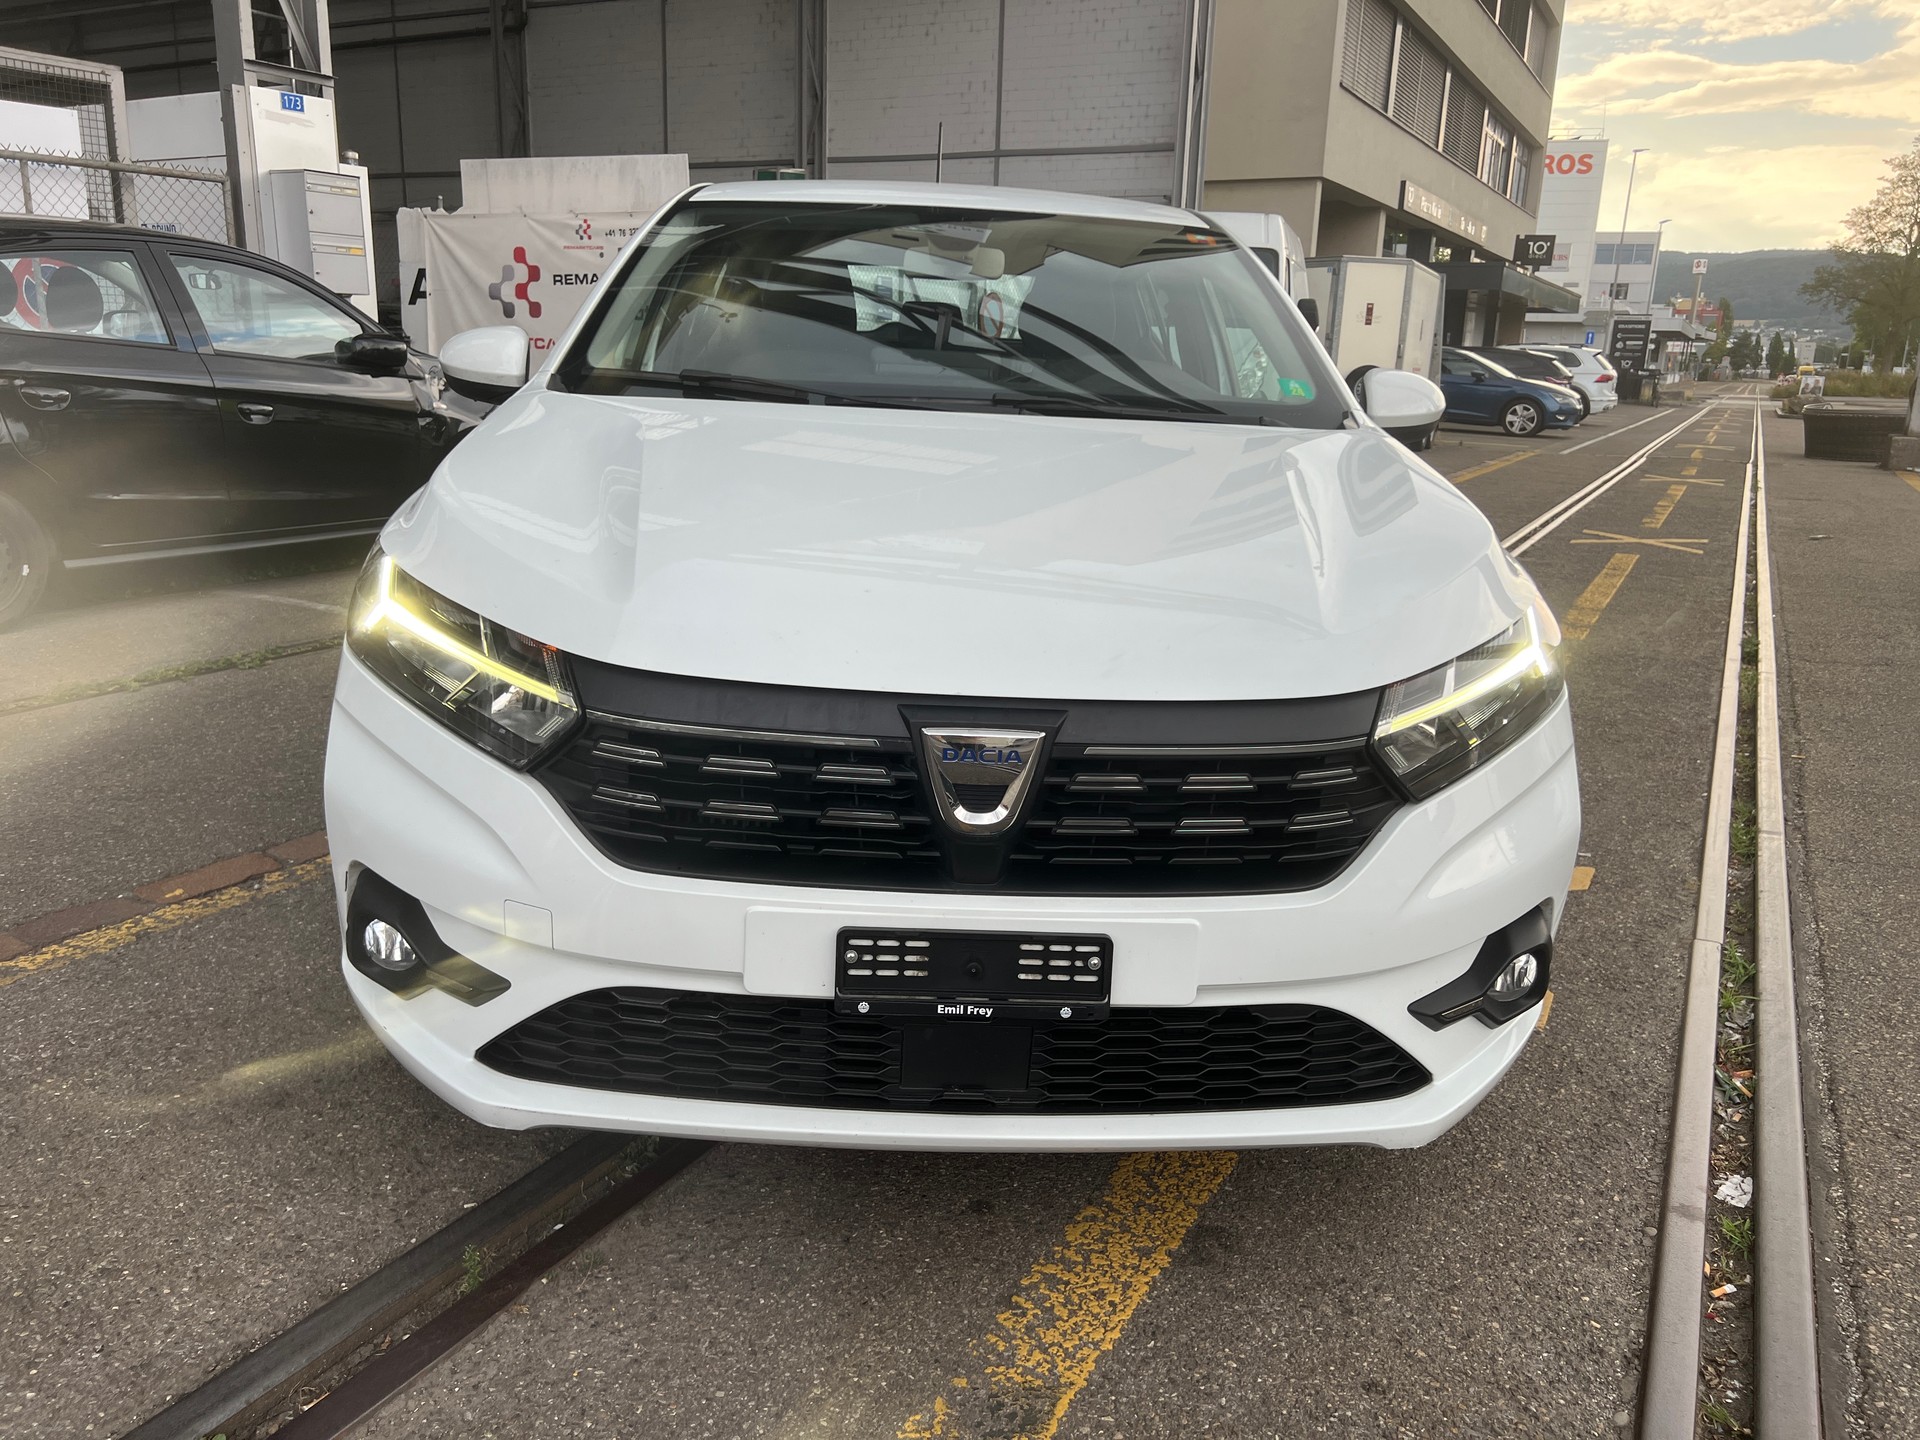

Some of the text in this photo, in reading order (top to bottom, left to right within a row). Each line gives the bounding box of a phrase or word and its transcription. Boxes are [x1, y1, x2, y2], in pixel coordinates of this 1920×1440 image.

[284, 95, 302, 110] 173
[618, 228, 627, 237] 76
[942, 748, 1022, 764] DACIA
[937, 1004, 994, 1018] Emil Frey
